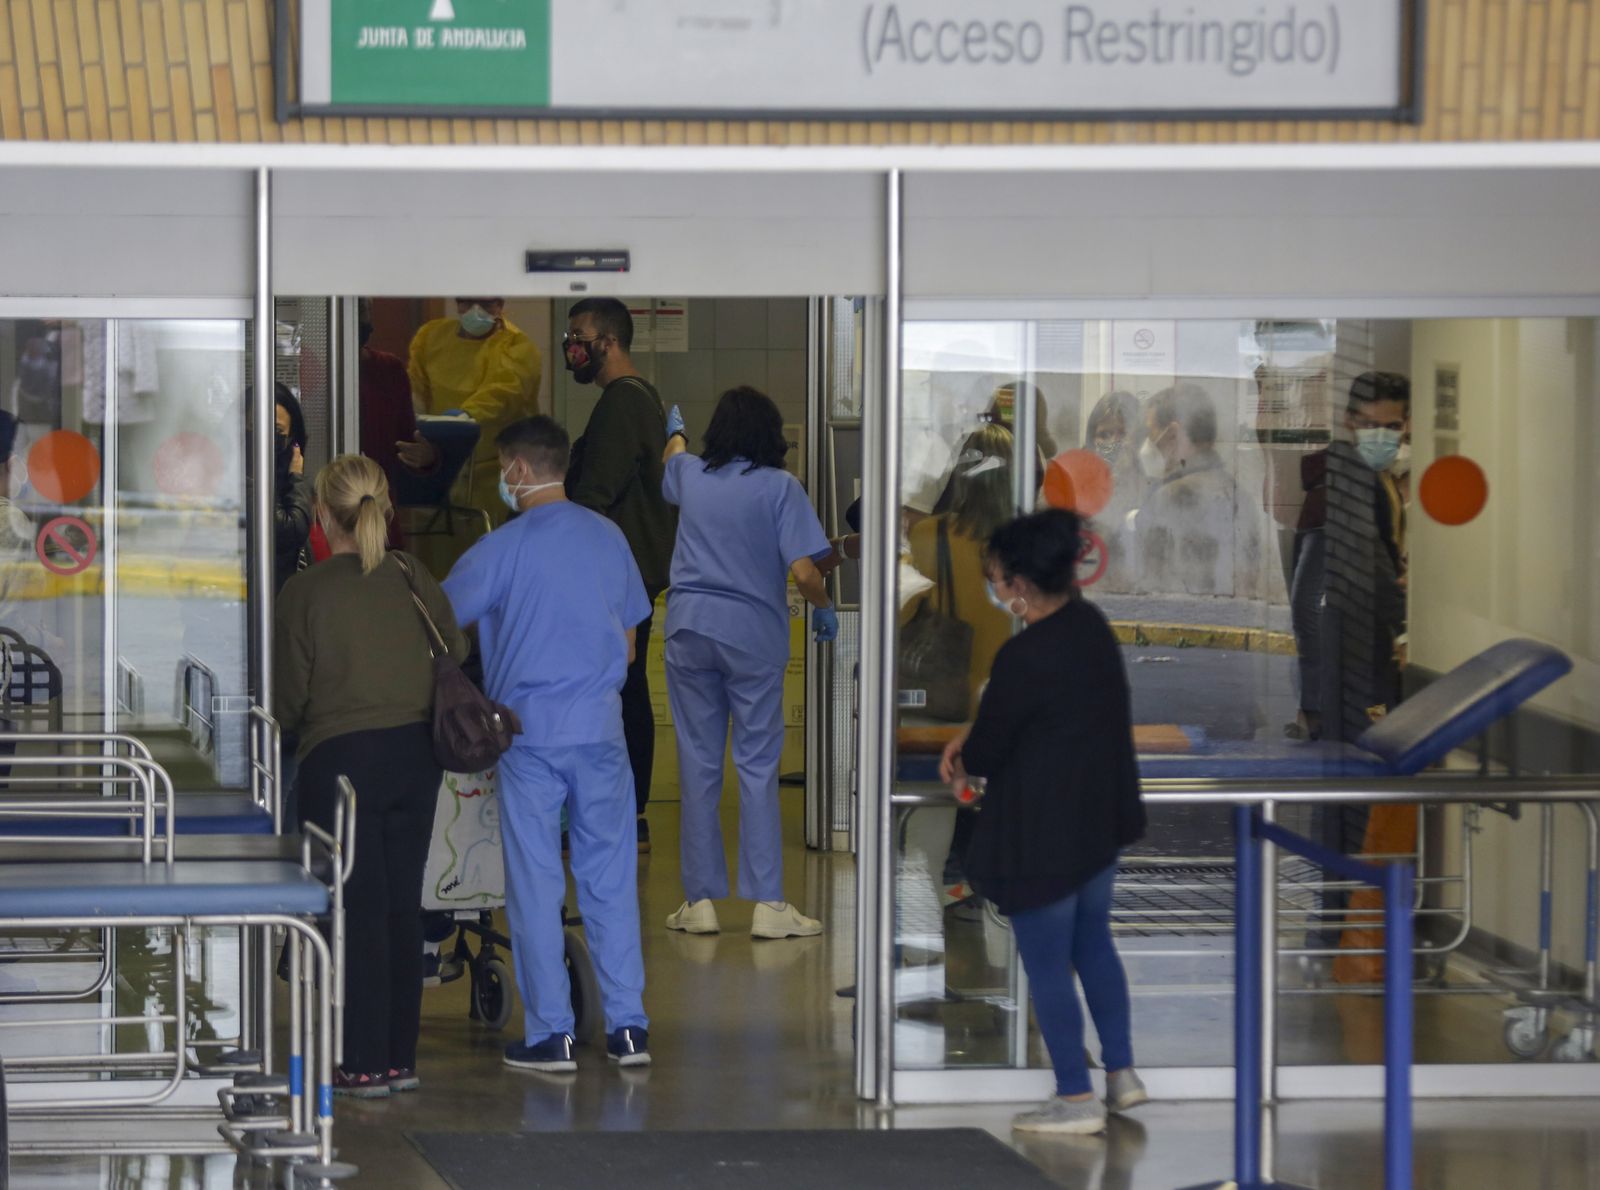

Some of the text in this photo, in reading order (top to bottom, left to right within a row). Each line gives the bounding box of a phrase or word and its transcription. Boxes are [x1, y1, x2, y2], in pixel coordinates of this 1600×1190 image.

[358, 26, 527, 49] JUNTA DE ANDALUCIA
[861, 3, 1342, 78] (Acceso Restringido)
